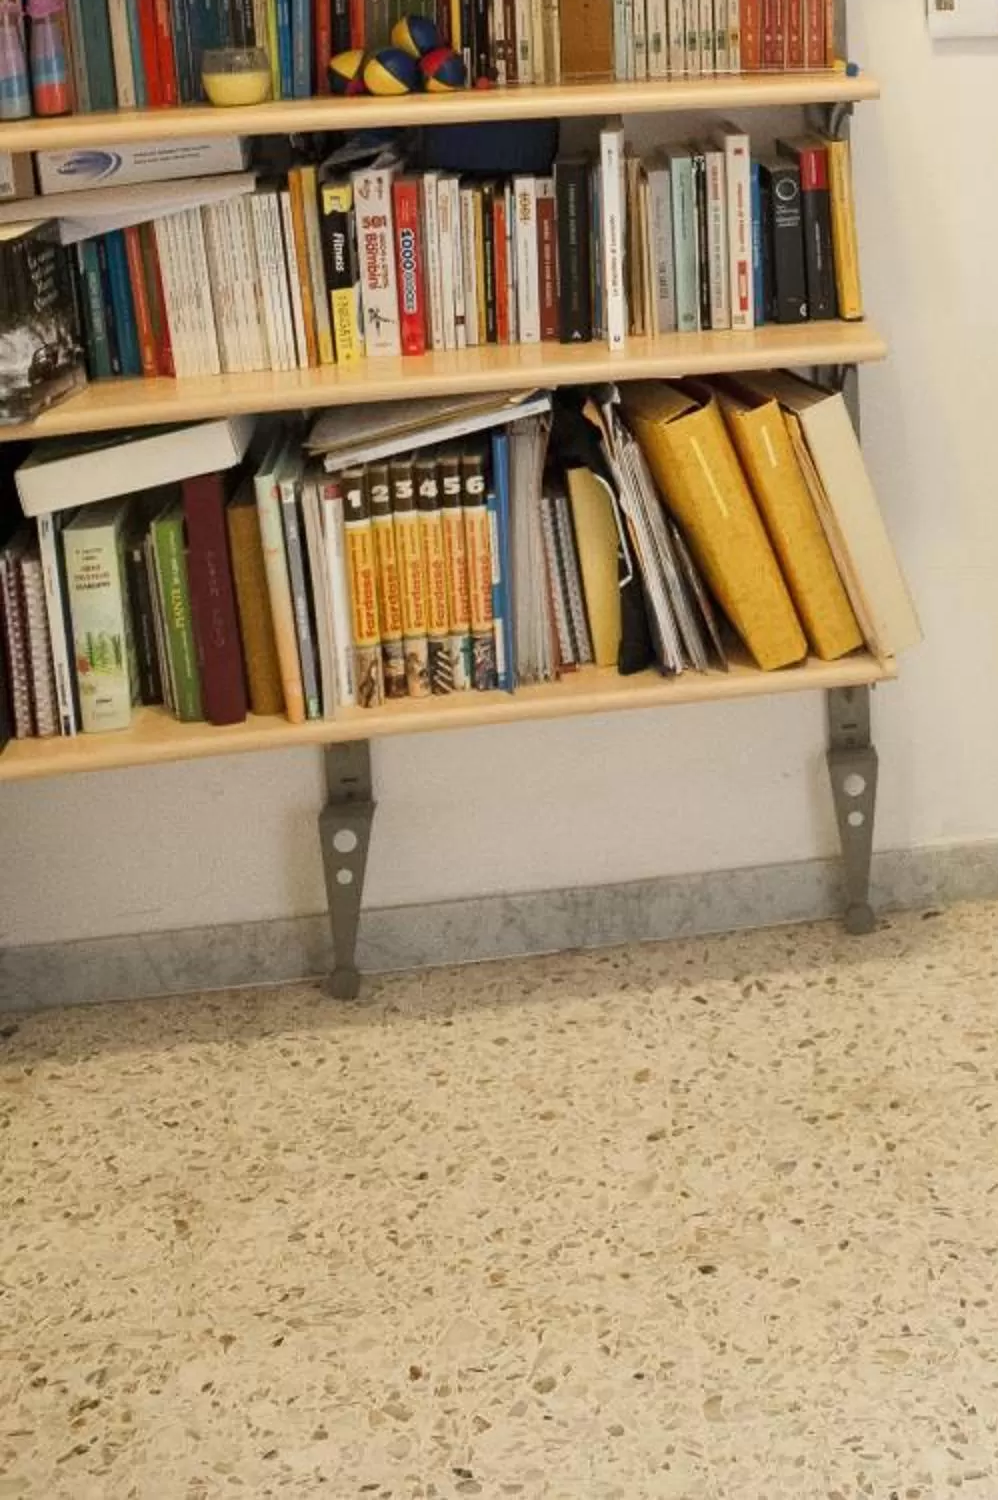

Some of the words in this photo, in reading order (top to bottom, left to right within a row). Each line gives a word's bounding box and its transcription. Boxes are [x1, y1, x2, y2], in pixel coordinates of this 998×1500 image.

[332, 232, 345, 273] Fitness
[364, 232, 382, 290] Bambini
[371, 484, 389, 503] 2
[395, 479, 413, 498] 3
[419, 478, 438, 498] 4
[443, 476, 461, 494] 5
[465, 475, 484, 494] 6
[347, 489, 361, 508] 1
